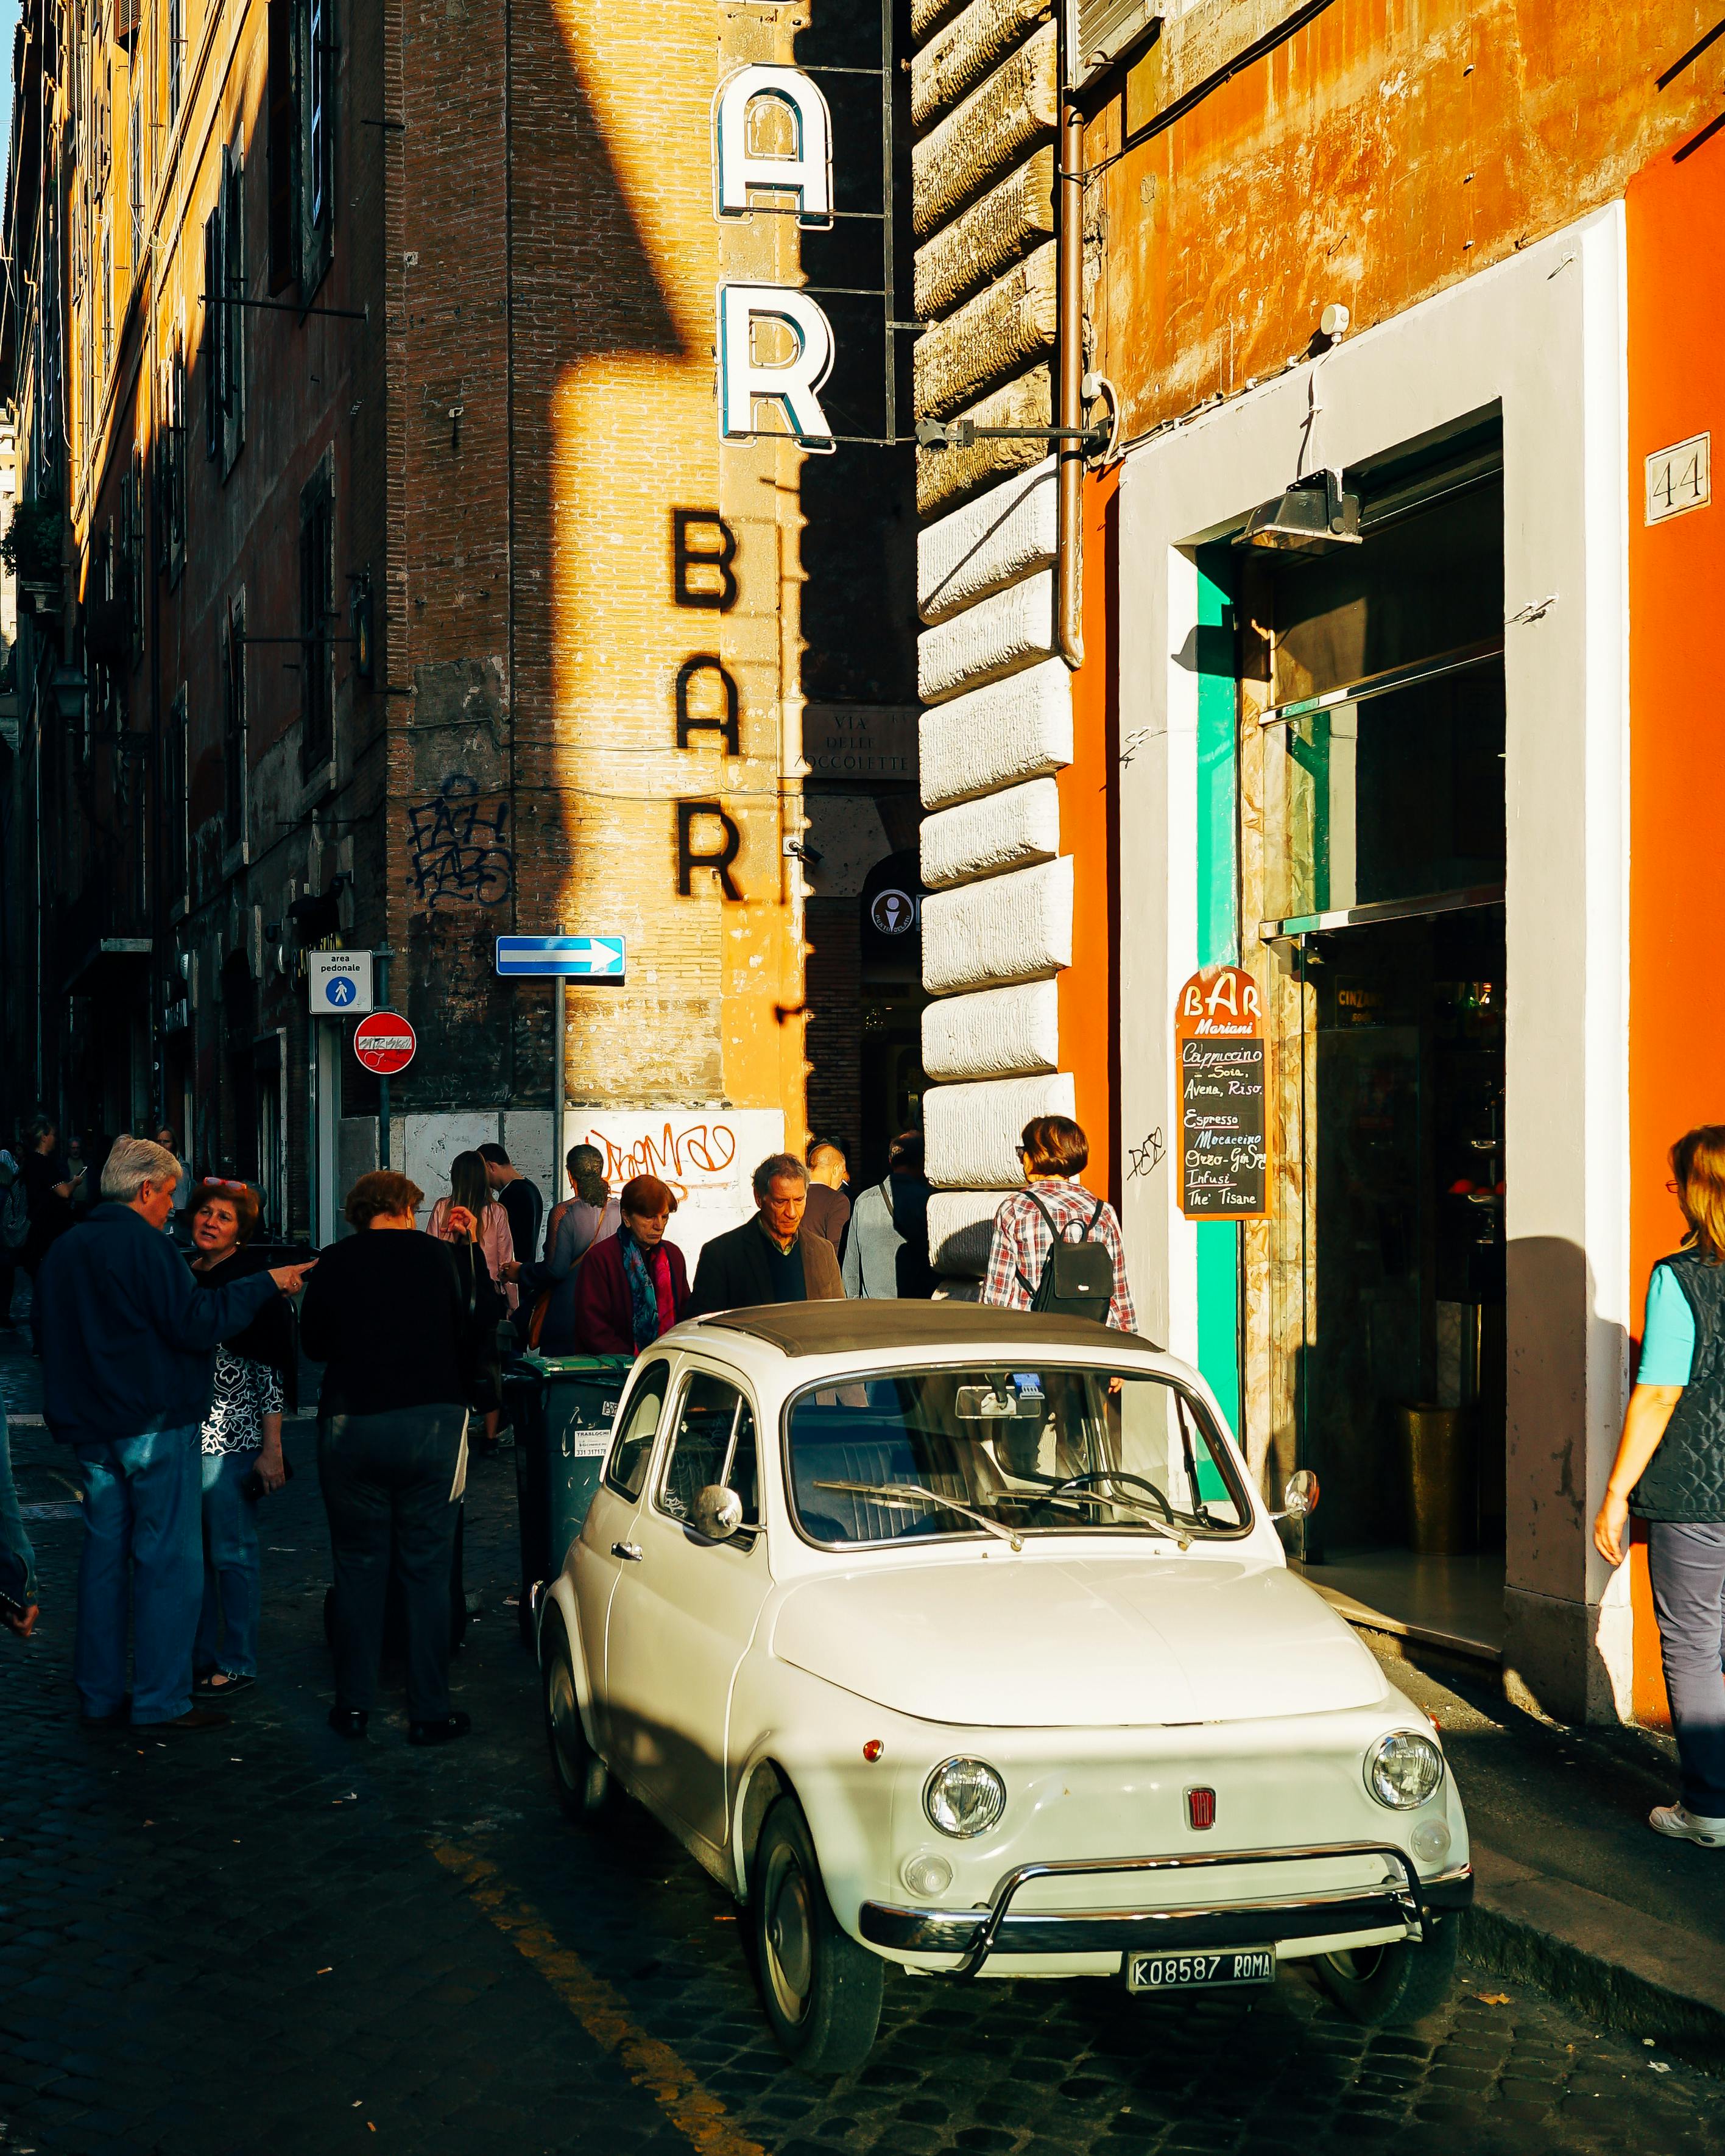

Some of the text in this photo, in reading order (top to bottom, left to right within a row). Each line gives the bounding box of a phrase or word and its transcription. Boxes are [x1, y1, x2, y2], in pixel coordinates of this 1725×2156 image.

[710, 0, 837, 454] AR
[1653, 450, 1704, 508] 44
[669, 507, 744, 903] BAR
[833, 716, 867, 730] VIA
[826, 736, 875, 749] DELLE
[320, 964, 361, 973] pedonale
[1184, 972, 1262, 1018] BAR
[1338, 989, 1383, 1008] CINZA
[1194, 1018, 1254, 1035] Mariani
[1183, 1042, 1263, 1069] Cappuccino
[1184, 1108, 1238, 1129] Espresso
[1185, 1169, 1230, 1187] Infusi
[1218, 1187, 1257, 1205] Tisane
[1135, 1954, 1270, 1985] K08587 ROMA
